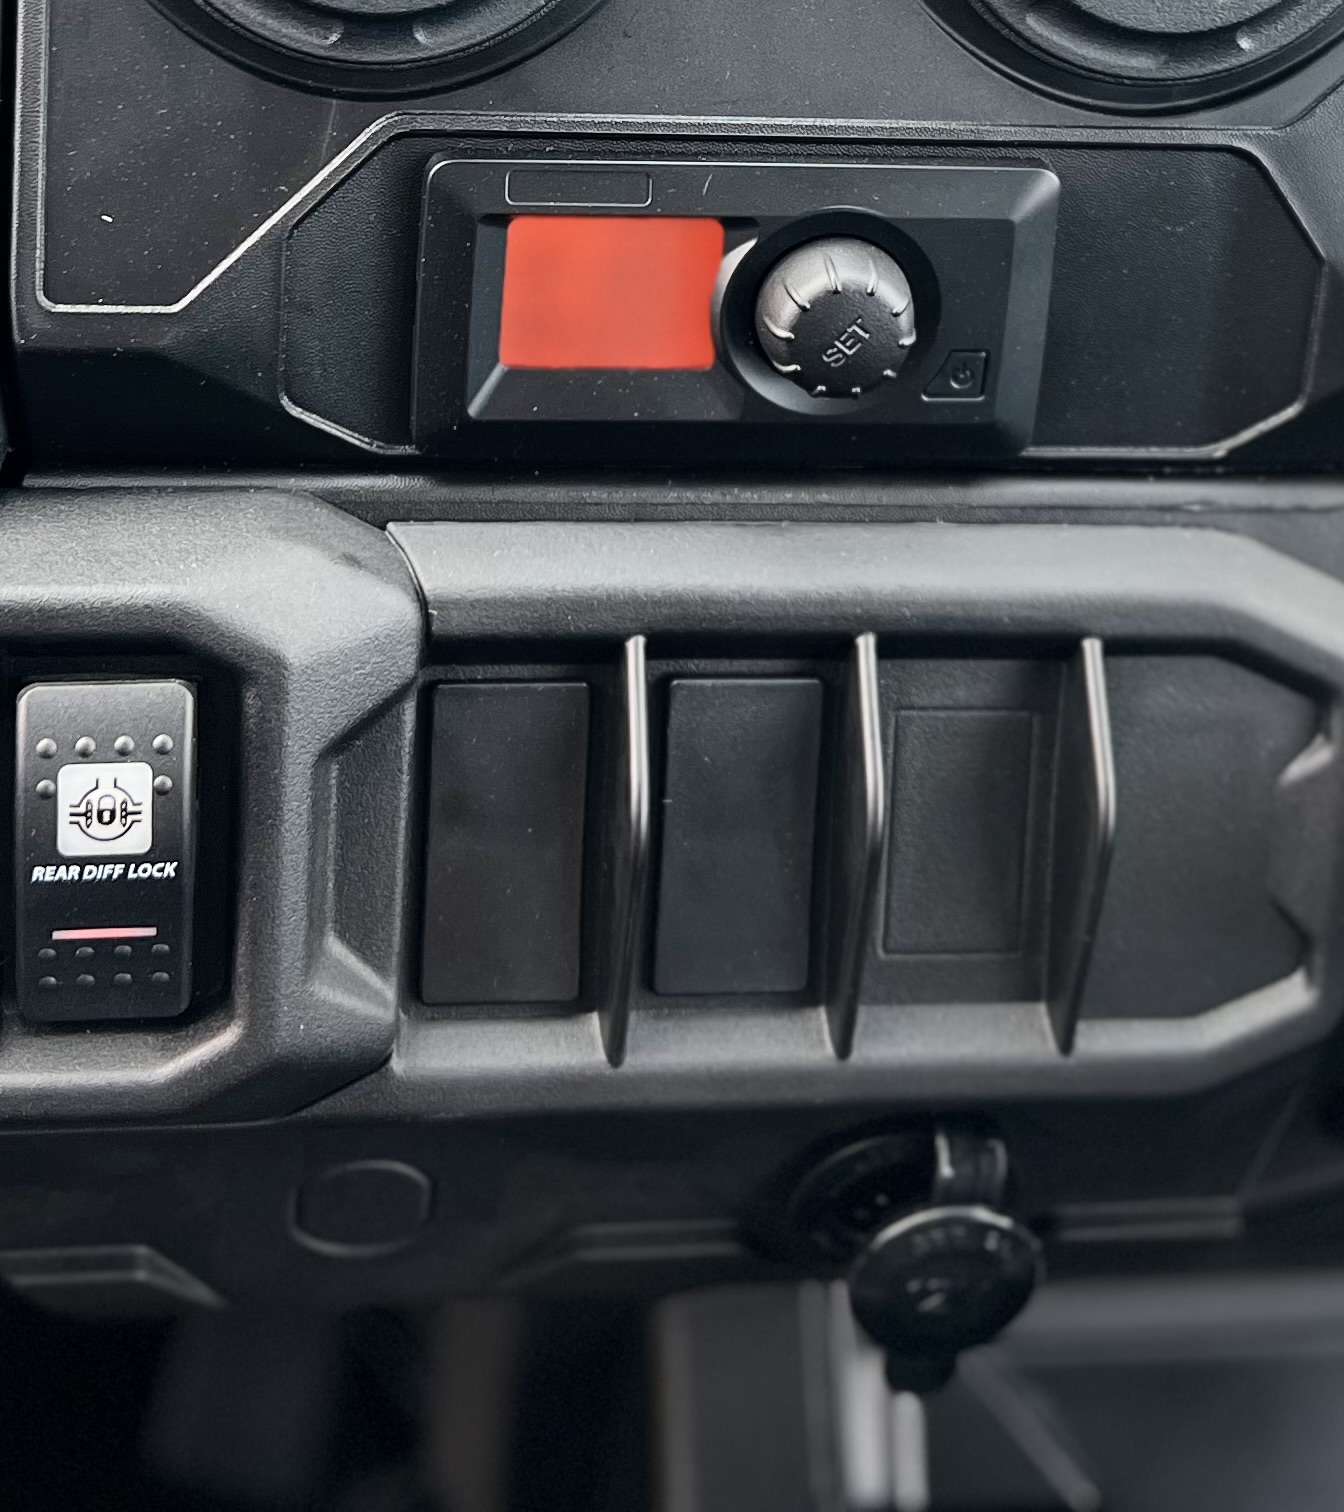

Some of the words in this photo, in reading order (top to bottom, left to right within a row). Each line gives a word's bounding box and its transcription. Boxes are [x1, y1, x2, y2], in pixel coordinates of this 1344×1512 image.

[821, 316, 870, 368] SET
[31, 865, 81, 883] REAR
[82, 863, 126, 882] DIFF
[127, 861, 179, 880] LOCK
